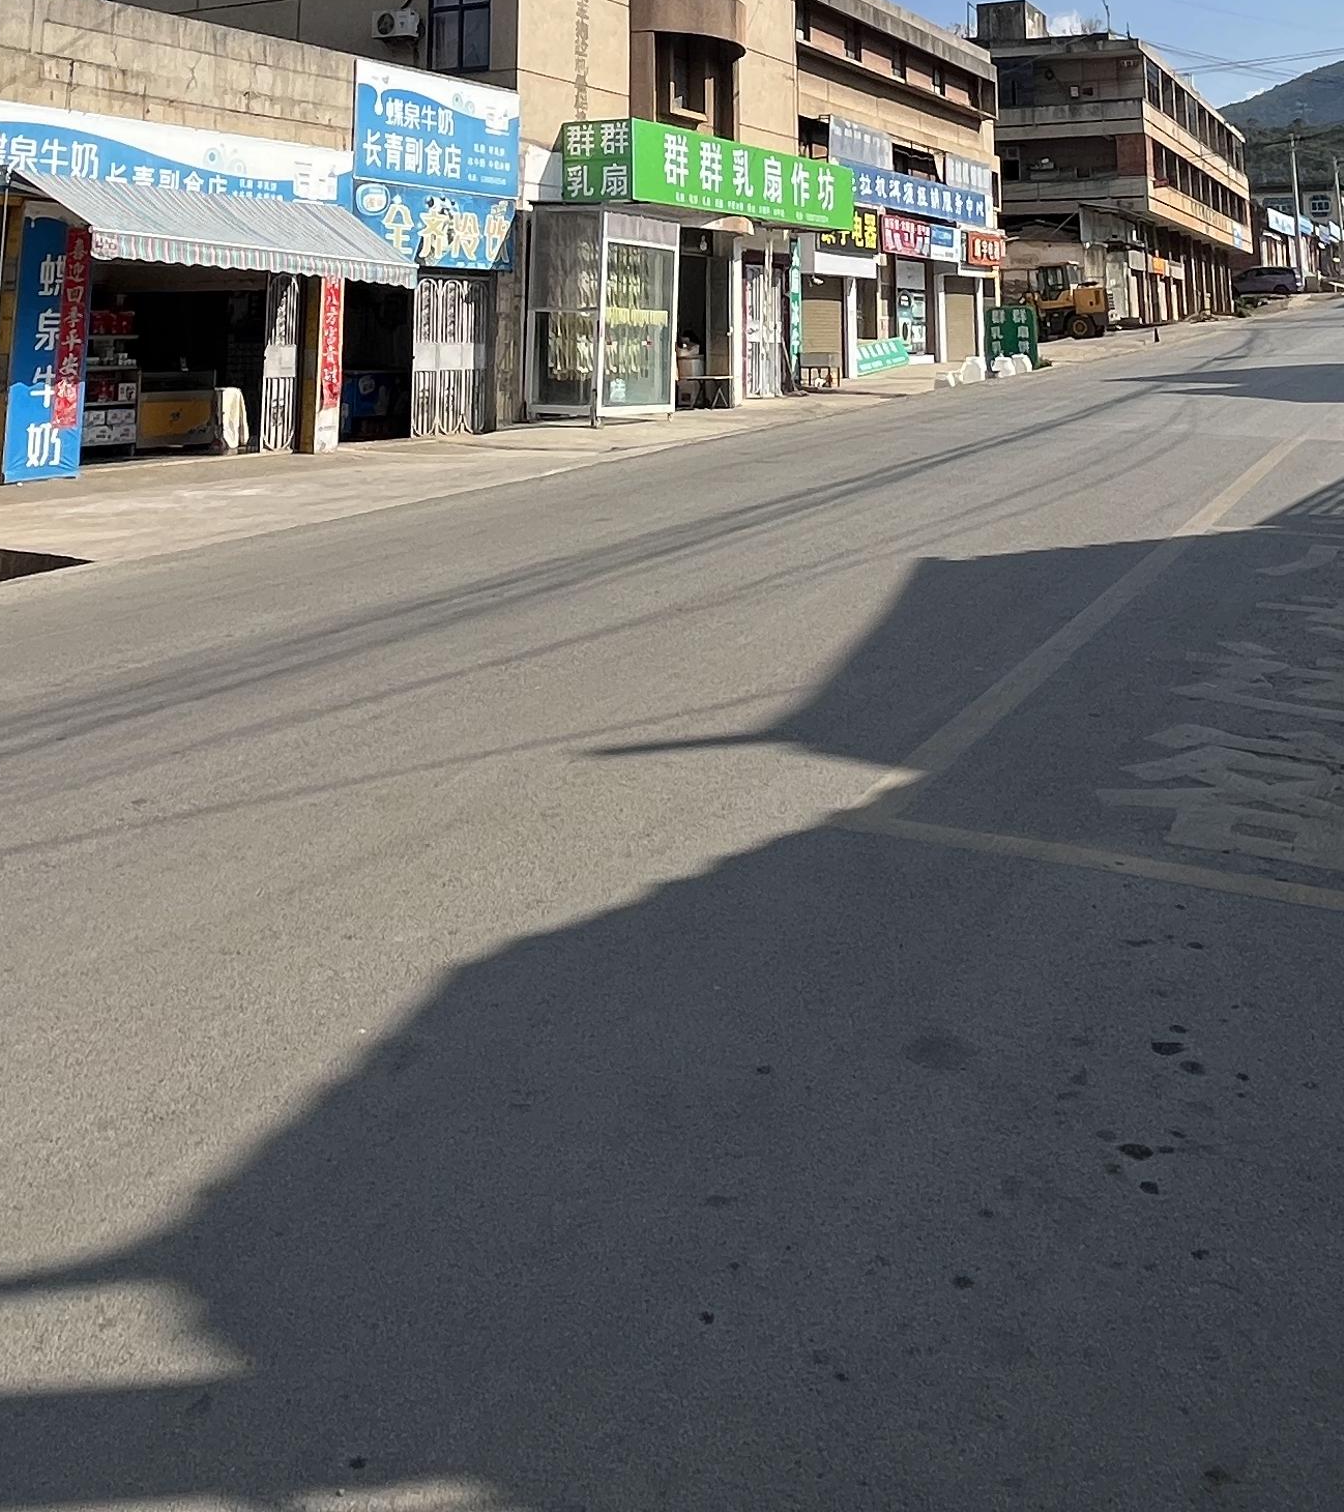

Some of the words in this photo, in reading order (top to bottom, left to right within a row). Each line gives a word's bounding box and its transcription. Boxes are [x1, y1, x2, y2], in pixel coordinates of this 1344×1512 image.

[385, 97, 455, 137] 蝶泉牛奶
[362, 128, 463, 180] 长青副食店
[566, 122, 629, 157] 群群
[567, 163, 629, 199] 乳扇
[662, 133, 836, 212] 群群乳扇作坊
